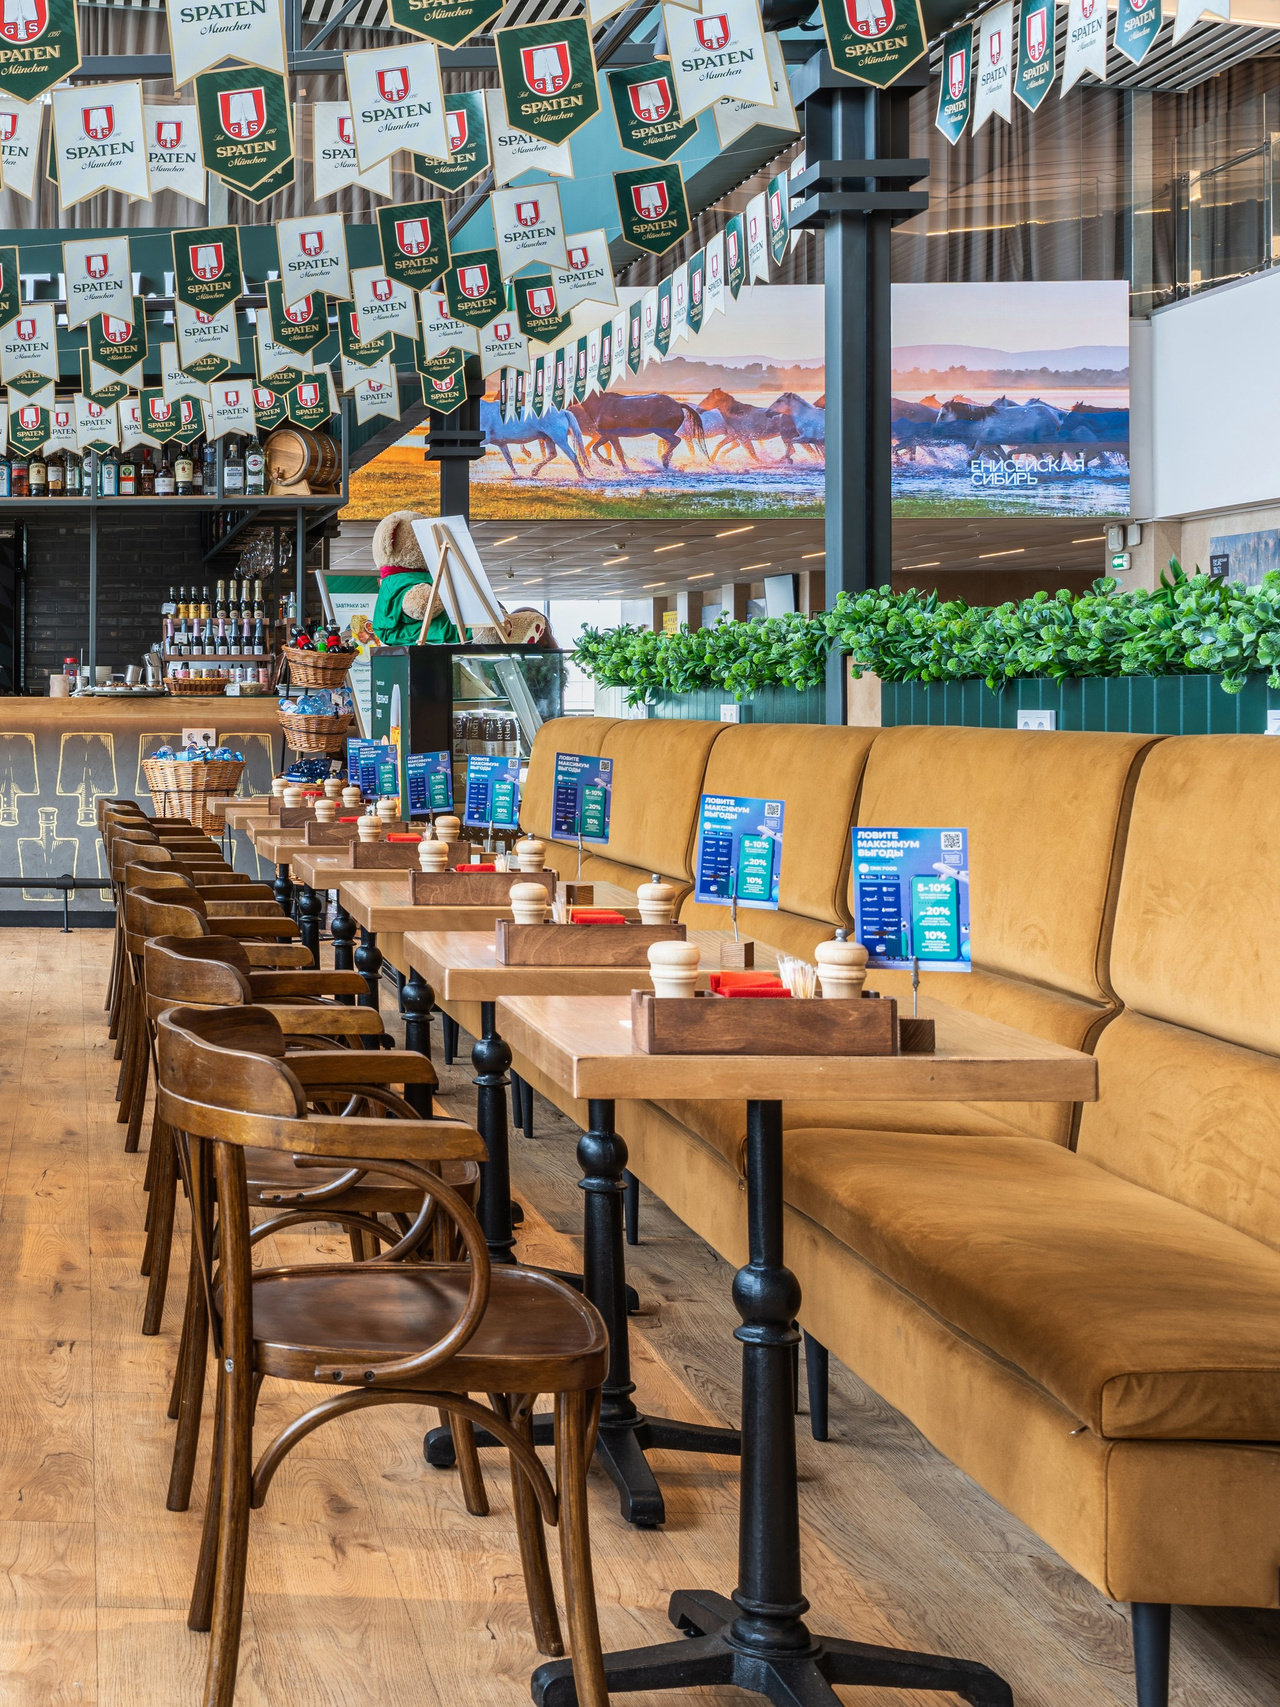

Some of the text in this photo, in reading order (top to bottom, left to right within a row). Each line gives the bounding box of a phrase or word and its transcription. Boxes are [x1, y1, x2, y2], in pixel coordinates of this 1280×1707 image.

[180, 0, 267, 24] SPATEN
[424, 5, 473, 22] München
[1124, 7, 1156, 33] SPATEN
[1071, 16, 1103, 43] SPATEN
[845, 35, 909, 59] SPATEN
[681, 48, 754, 72] SPATEN
[0, 63, 49, 76] München
[981, 64, 1008, 86] SPATEN
[1022, 60, 1050, 82] SPATEN
[520, 94, 584, 116] SPATEN
[944, 99, 967, 116] SPATEN
[361, 102, 432, 123] SPATEN
[631, 120, 684, 140] SPATEN
[66, 140, 135, 160] SPATEN
[216, 140, 277, 158] SPATEN
[633, 218, 678, 234] SPATEN
[504, 226, 556, 244] SPATEN
[288, 257, 340, 272] SPATEN
[394, 256, 439, 270] SPATEN
[558, 269, 605, 285] SPATEN
[73, 280, 123, 293] SPATEN
[187, 281, 231, 293] SPATEN
[362, 301, 407, 315] SPATEN
[457, 297, 497, 311] SPATEN
[527, 316, 563, 328] SPATEN
[184, 324, 229, 337] SPATEN
[281, 324, 319, 336] SPATEN
[5, 342, 49, 353] SPATEN
[100, 345, 138, 355] SPATEN
[350, 340, 385, 351] SPATEN
[485, 342, 522, 352] SPATEN
[423, 357, 456, 367] SPATEN
[360, 391, 393, 402] SPATEN
[430, 391, 459, 400] SPATEN
[216, 407, 249, 416] SPATEN
[295, 407, 324, 416] SPATEN
[80, 419, 112, 427] SPATEN
[148, 420, 176, 429] SPATEN
[971, 473, 1038, 485] СИБИРЬ
[705, 797, 735, 806] ЛОВИТЕ
[704, 804, 750, 814] МАКСИМУМ
[704, 811, 738, 820] ВЫГОДЫ
[857, 831, 898, 839] ЛОВИТЕ
[744, 840, 769, 849] 5-10%
[857, 840, 920, 848] МАКСИМУМ
[858, 849, 903, 858] ВЫГОДЫ
[749, 858, 767, 866] 20%
[917, 884, 951, 892] 5-10%
[926, 907, 950, 915] 20%
[924, 931, 947, 939] 10%
